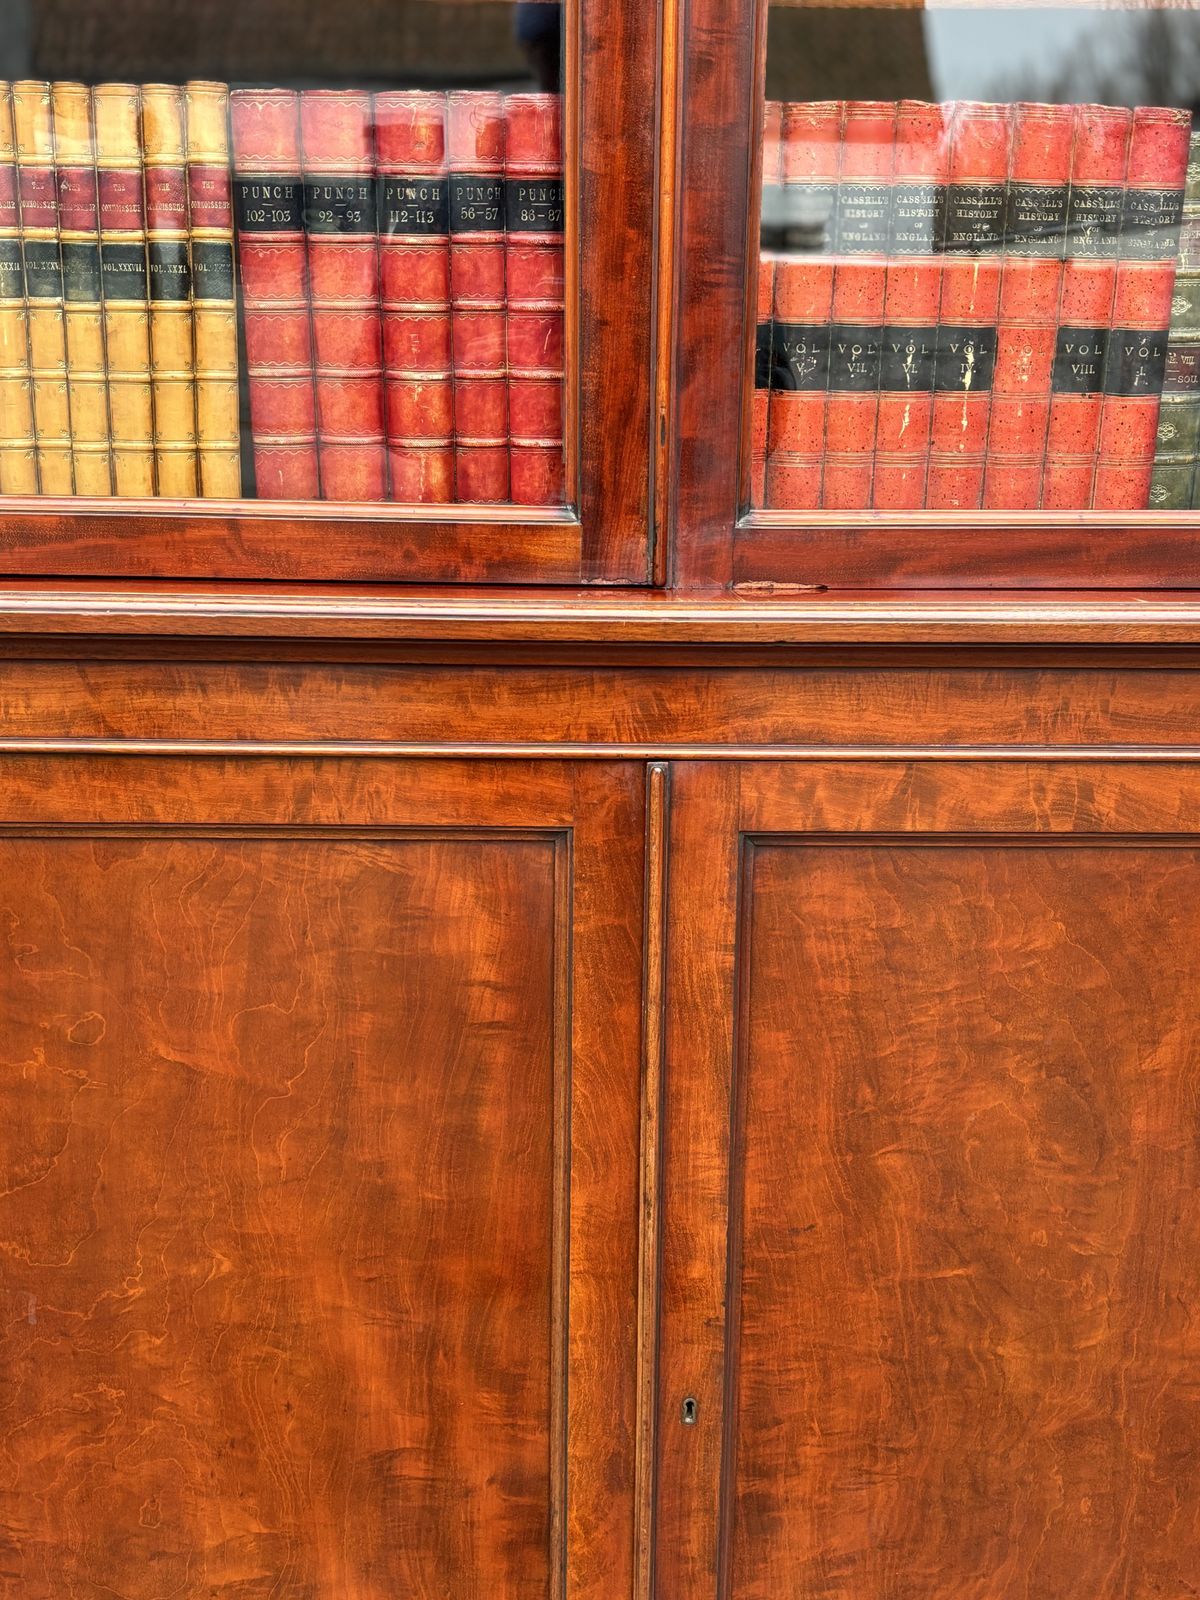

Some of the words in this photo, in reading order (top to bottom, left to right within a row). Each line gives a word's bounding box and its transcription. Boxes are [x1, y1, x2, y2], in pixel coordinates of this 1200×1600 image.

[242, 186, 294, 199] PUNCH
[313, 186, 368, 200] PUNCH
[386, 188, 440, 200] PUNCH
[456, 187, 501, 200] PUNCH
[518, 187, 564, 201] PUNCH
[247, 210, 291, 222] 102-103
[390, 210, 434, 223] 112-113
[844, 208, 885, 218] HISTORY
[899, 208, 940, 217] HISTORY
[956, 209, 998, 218] HISTORY
[1018, 212, 1060, 221] HISTORY
[1075, 213, 1117, 223] HISTORY
[895, 232, 940, 241] ENGLAD
[953, 232, 1000, 241] ENGLAND
[783, 342, 820, 354] VOL
[838, 343, 875, 355] VOL
[892, 343, 929, 354] VOL
[950, 343, 987, 355] VOL
[1065, 344, 1102, 355] VOL
[1125, 347, 1160, 358] VOL
